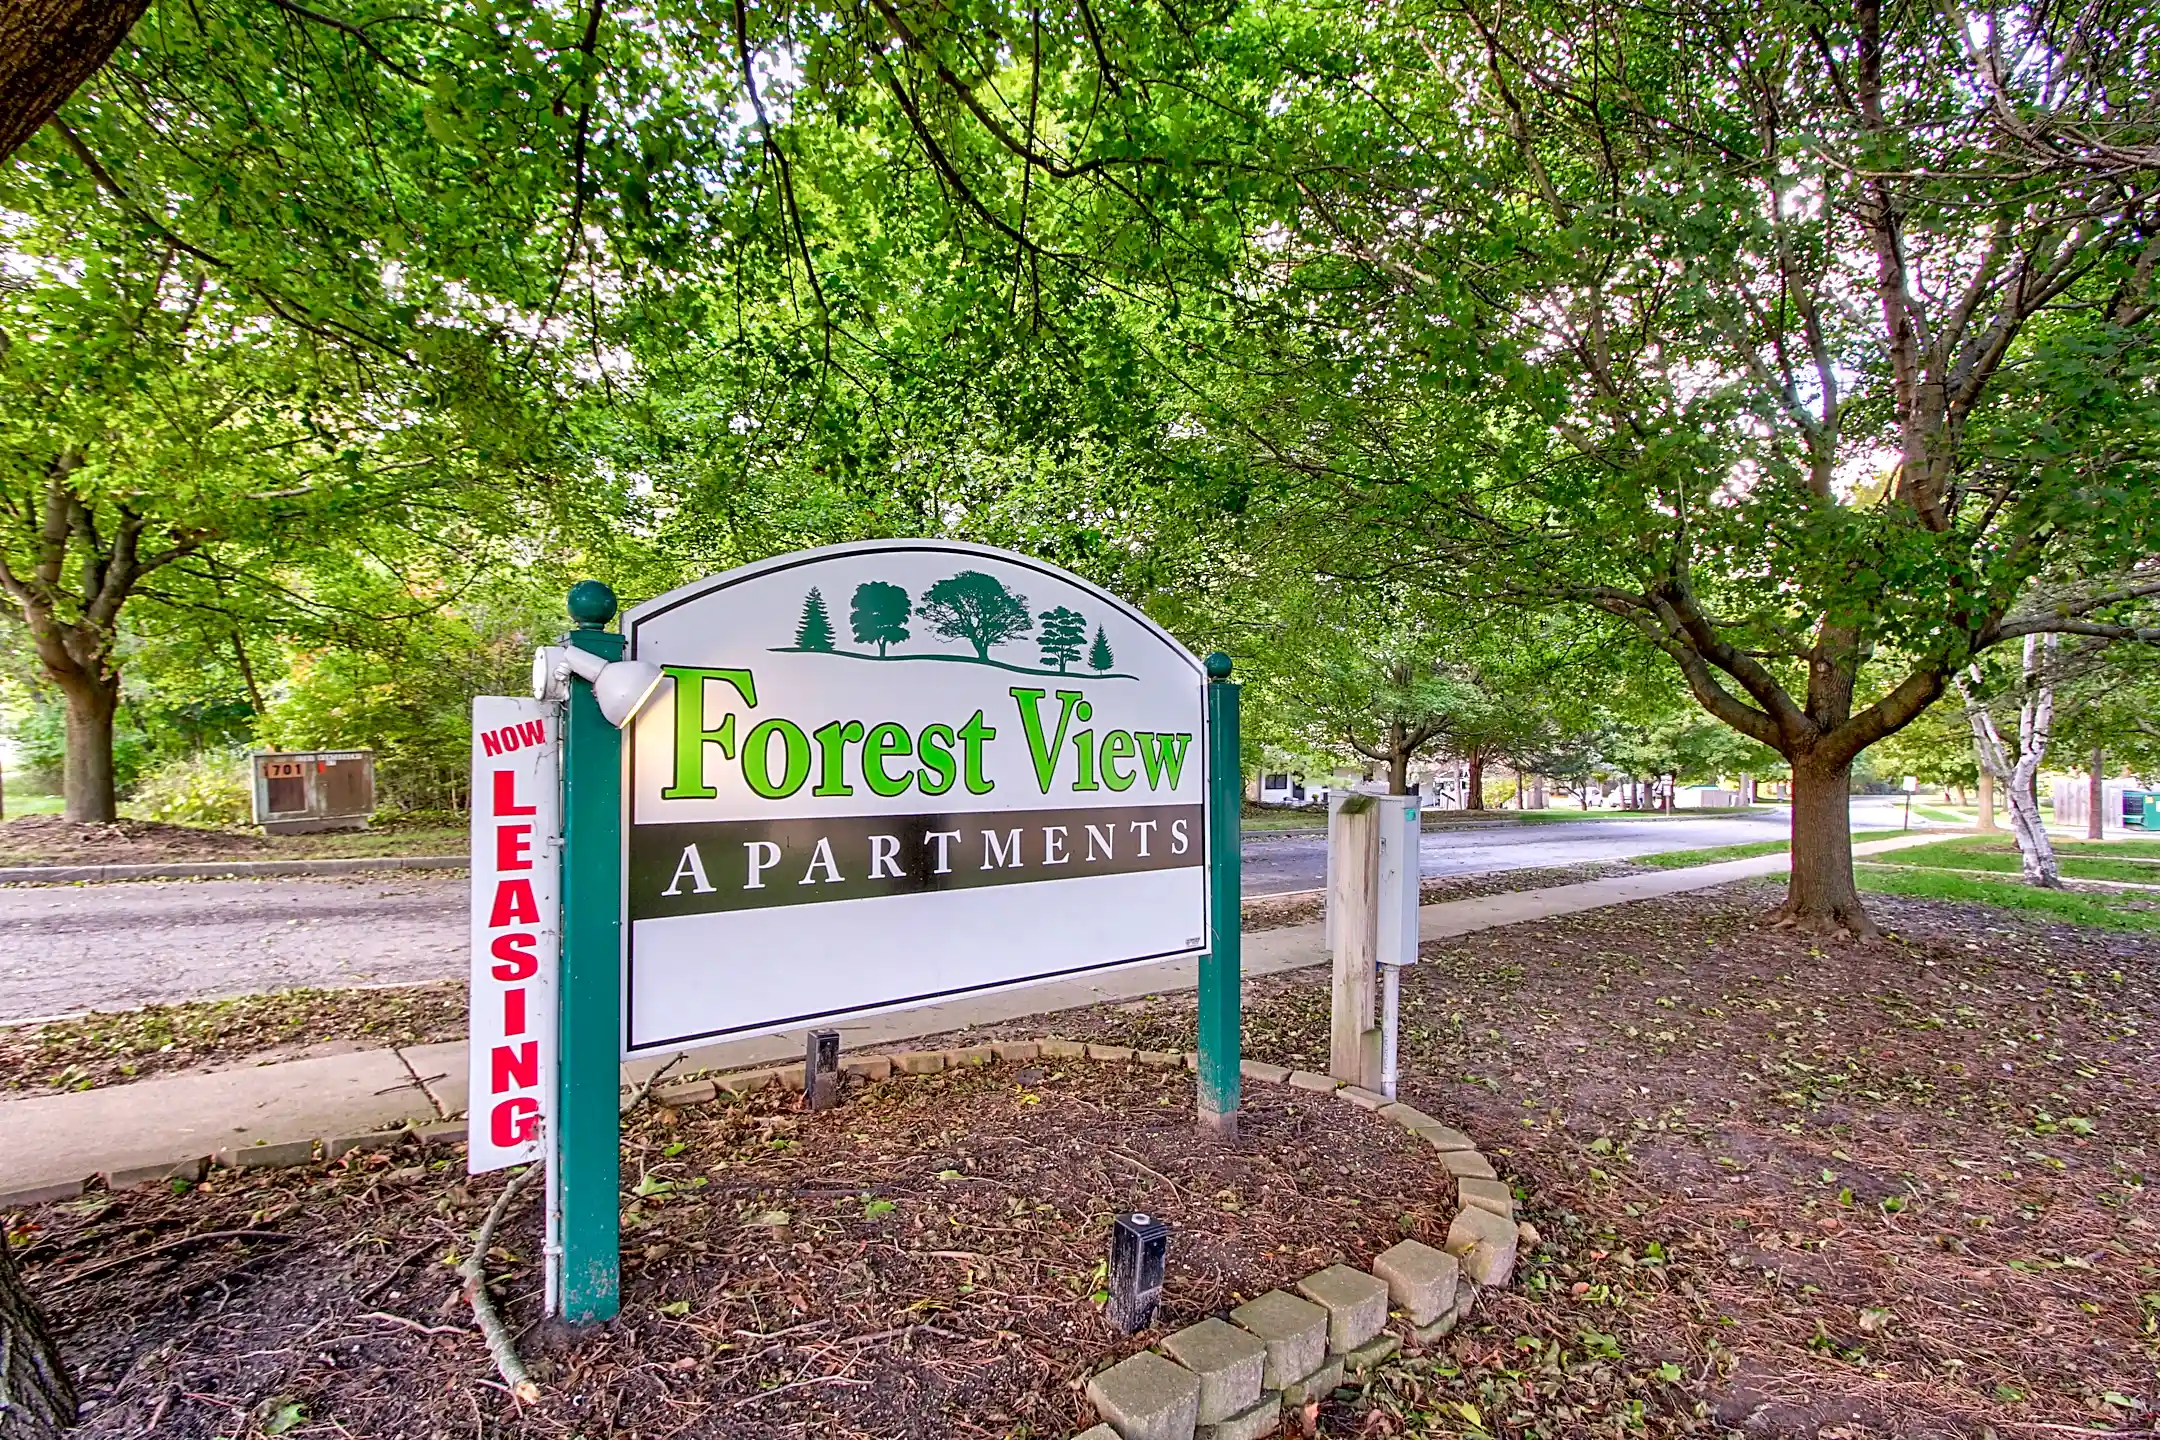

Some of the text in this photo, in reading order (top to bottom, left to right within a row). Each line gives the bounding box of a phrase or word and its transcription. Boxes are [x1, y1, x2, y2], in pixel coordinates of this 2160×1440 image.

[480, 719, 546, 757] NOW
[661, 665, 1192, 800] Forest View
[661, 818, 1190, 897] APARTMENTS
[489, 770, 540, 1148] LEASING
